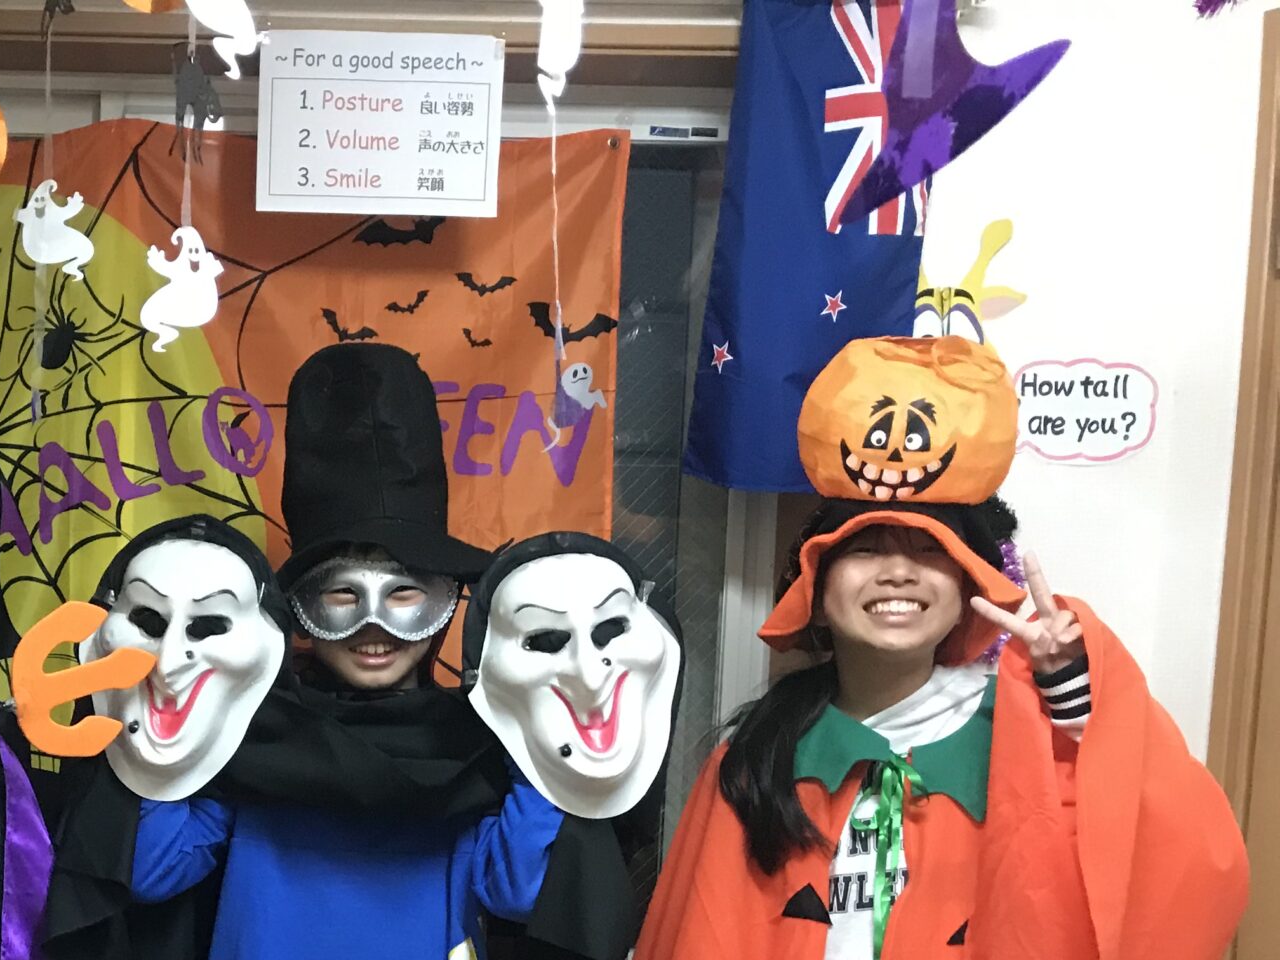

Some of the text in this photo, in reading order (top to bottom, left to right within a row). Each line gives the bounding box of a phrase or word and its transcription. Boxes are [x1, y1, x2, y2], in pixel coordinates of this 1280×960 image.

[332, 56, 343, 67] a
[349, 51, 393, 73] good
[299, 90, 404, 112] 1. Posture
[298, 128, 400, 152] 2. Volume
[418, 139, 485, 154] 声の大きさ
[297, 167, 382, 189] 3. Smile
[416, 177, 445, 192] 笑顔
[1021, 373, 1129, 399] How tall
[1028, 412, 1137, 442] are you?
